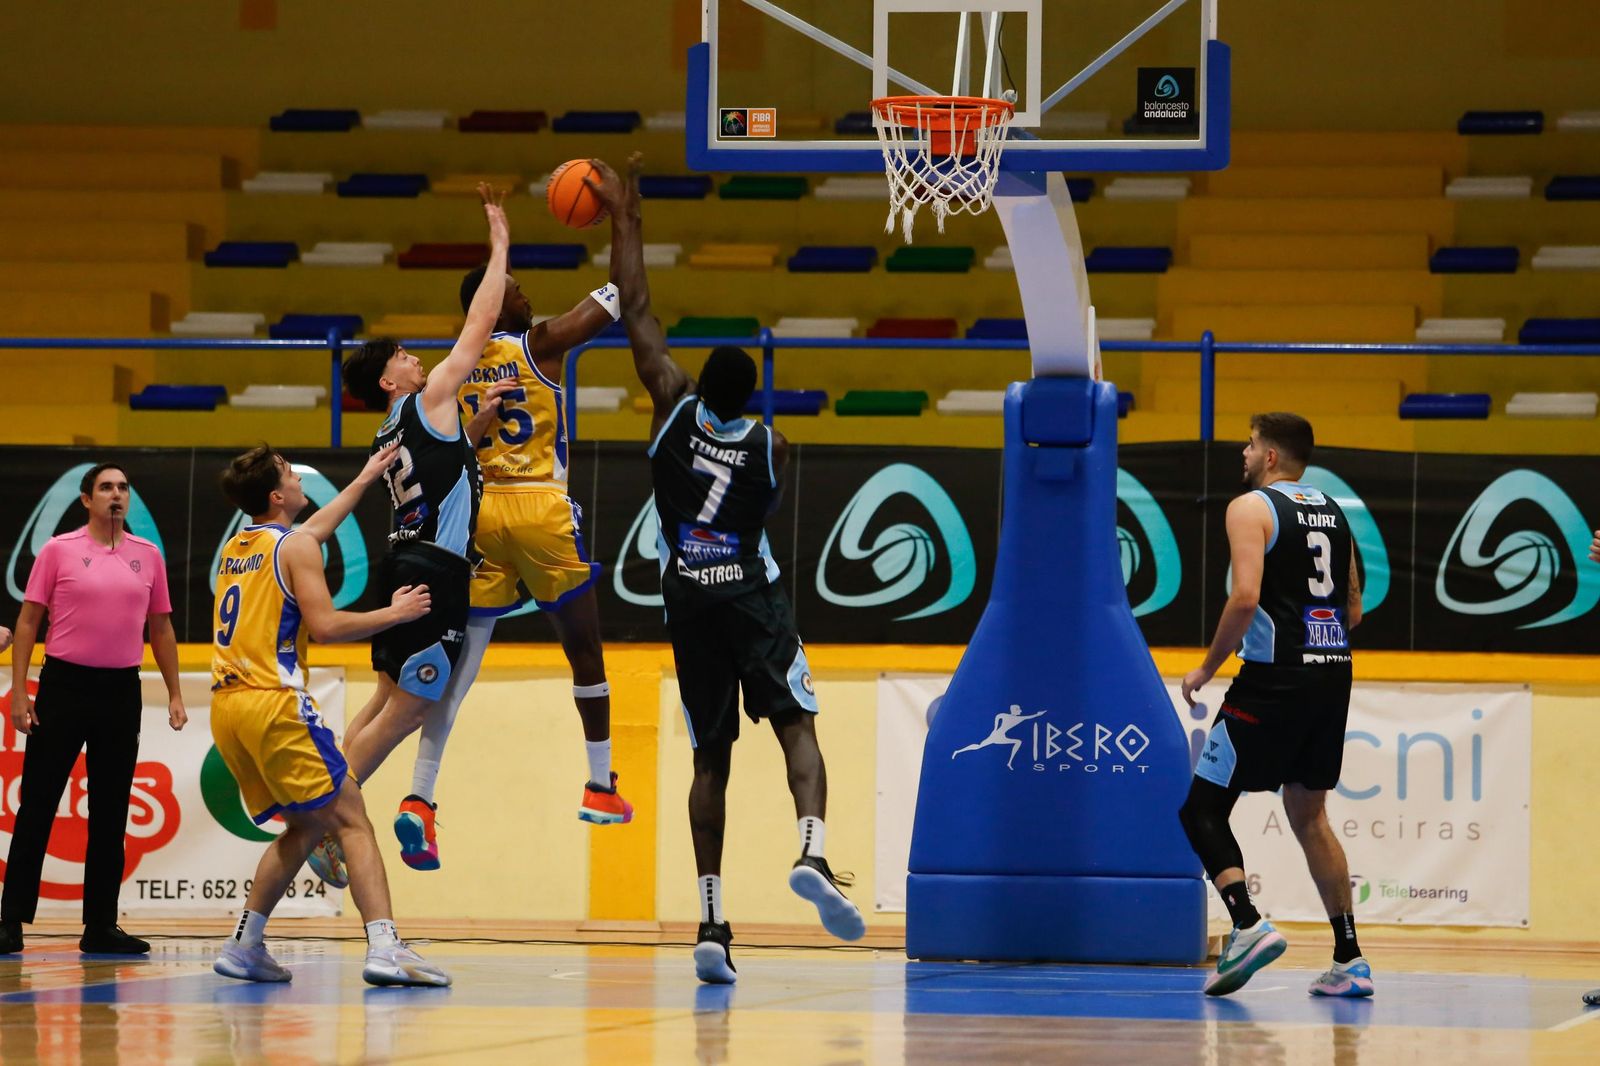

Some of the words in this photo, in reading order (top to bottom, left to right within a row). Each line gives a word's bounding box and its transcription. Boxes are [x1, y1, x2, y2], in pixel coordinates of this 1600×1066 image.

[752, 113, 771, 122] FIBA
[1144, 101, 1190, 110] baloncesto
[689, 435, 749, 466] TOURE
[692, 454, 732, 523] 7
[1306, 531, 1335, 597] 3
[217, 584, 241, 647] 9
[1033, 722, 1150, 762] IBERO
[1033, 763, 1150, 773] SPORT
[1262, 810, 1481, 842] Aeciras
[136, 880, 195, 899] TELF:
[202, 879, 237, 899] 652
[303, 879, 327, 898] 24
[1379, 884, 1469, 903] Telebearing
